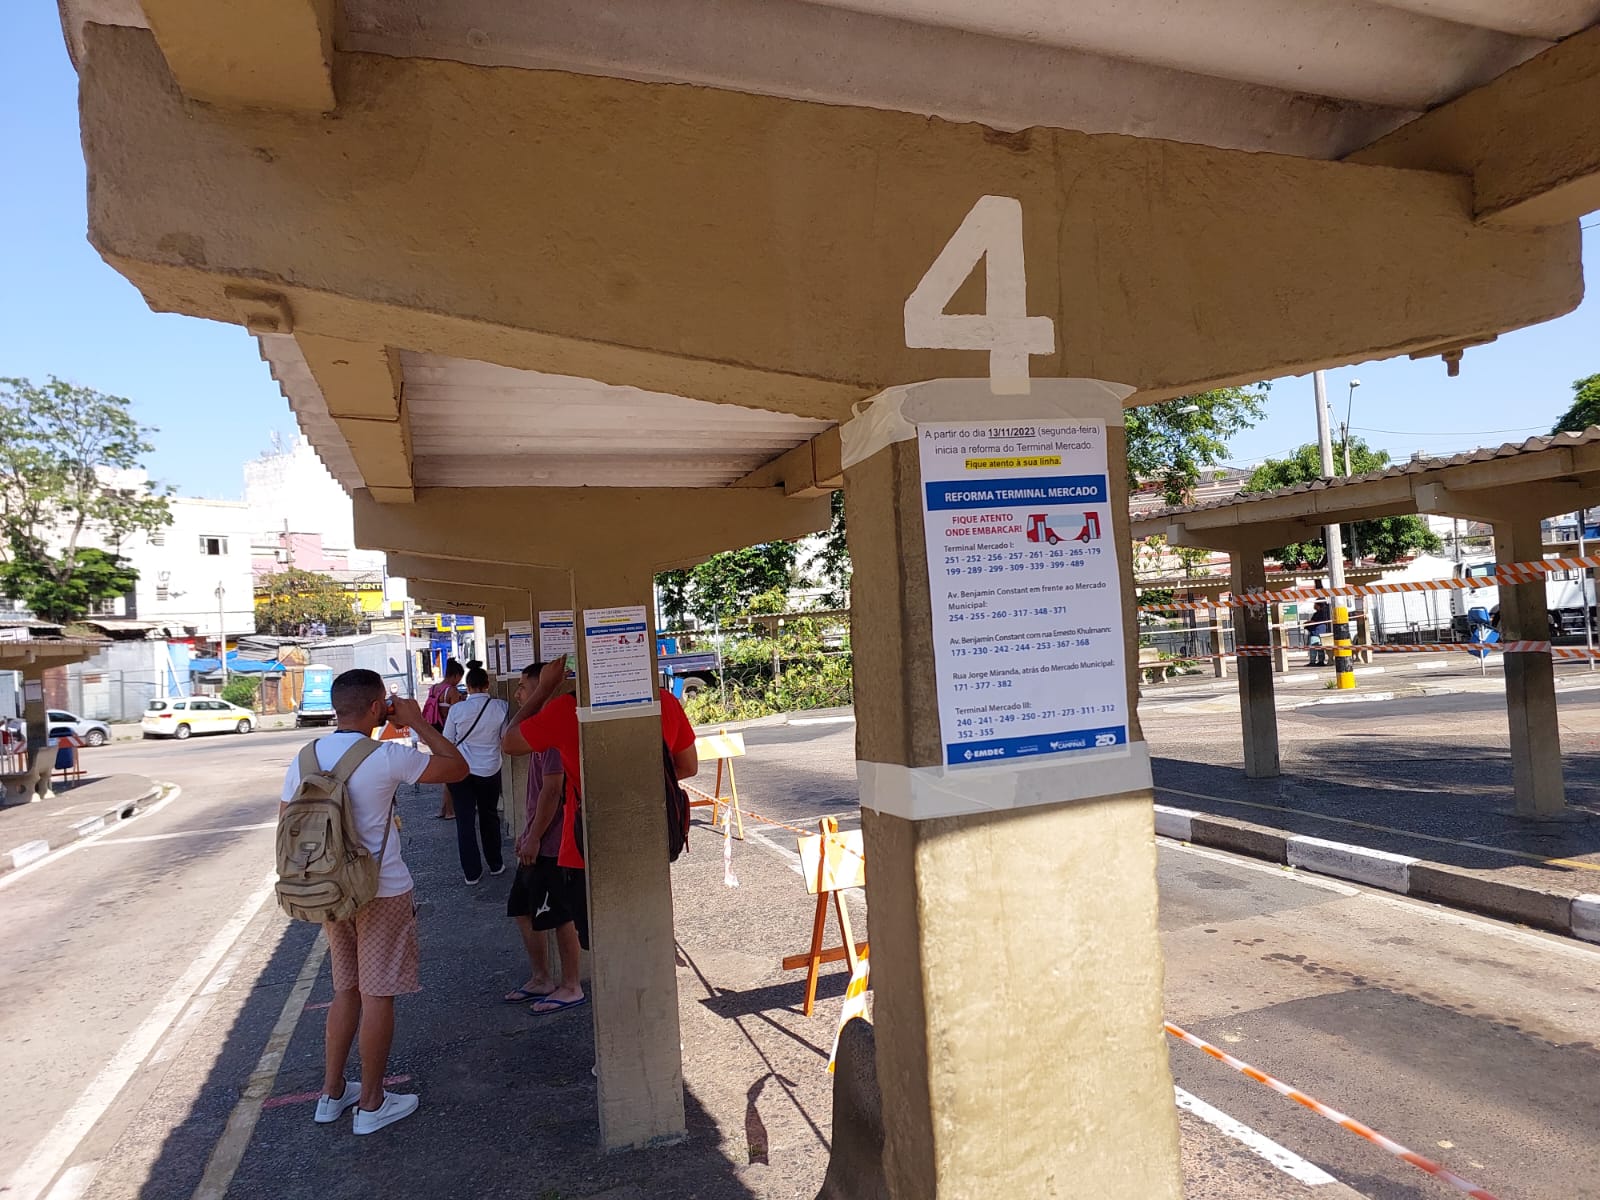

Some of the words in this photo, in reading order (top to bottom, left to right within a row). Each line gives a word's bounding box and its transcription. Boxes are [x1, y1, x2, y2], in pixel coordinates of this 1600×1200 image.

[904, 195, 1055, 394] 4
[934, 430, 956, 440] partir
[959, 429, 970, 438] do
[973, 429, 986, 437] dia
[988, 427, 1036, 437] 13/11/2023
[1038, 426, 1100, 437] (segunda-feira)
[935, 446, 958, 454] inicia
[969, 444, 1000, 453] reforma
[1003, 444, 1014, 452] do
[1017, 442, 1052, 452] Terminal
[966, 460, 987, 469] Fique
[989, 459, 1014, 467] atento
[1016, 458, 1021, 466] à
[1040, 456, 1061, 465] linha.
[945, 489, 994, 502] REFORMA
[995, 488, 1046, 499] TERMINAL
[1048, 486, 1097, 497] MERCADO
[952, 515, 977, 525] FIQUE
[980, 514, 1013, 522] ATENTO
[945, 528, 970, 536] ONDE
[972, 525, 1022, 535] EMBARCAR!
[944, 544, 976, 552] Terminal
[977, 542, 1008, 550] Mercado
[961, 589, 995, 598] Benjamin
[997, 588, 1028, 596] Constant
[948, 601, 988, 611] Municipal:
[962, 635, 994, 644] Benjamin
[995, 633, 1025, 641] Constant
[1053, 629, 1076, 637] Ernesto
[968, 671, 988, 680] Jorge
[990, 668, 1020, 677] Miranda,
[1022, 666, 1039, 675] atrás
[1051, 663, 1078, 672] Mercado
[1080, 660, 1115, 670] Municipal:
[955, 706, 987, 715] Terminal
[989, 703, 1021, 712] Mercado
[974, 748, 1004, 757] EMDEC
